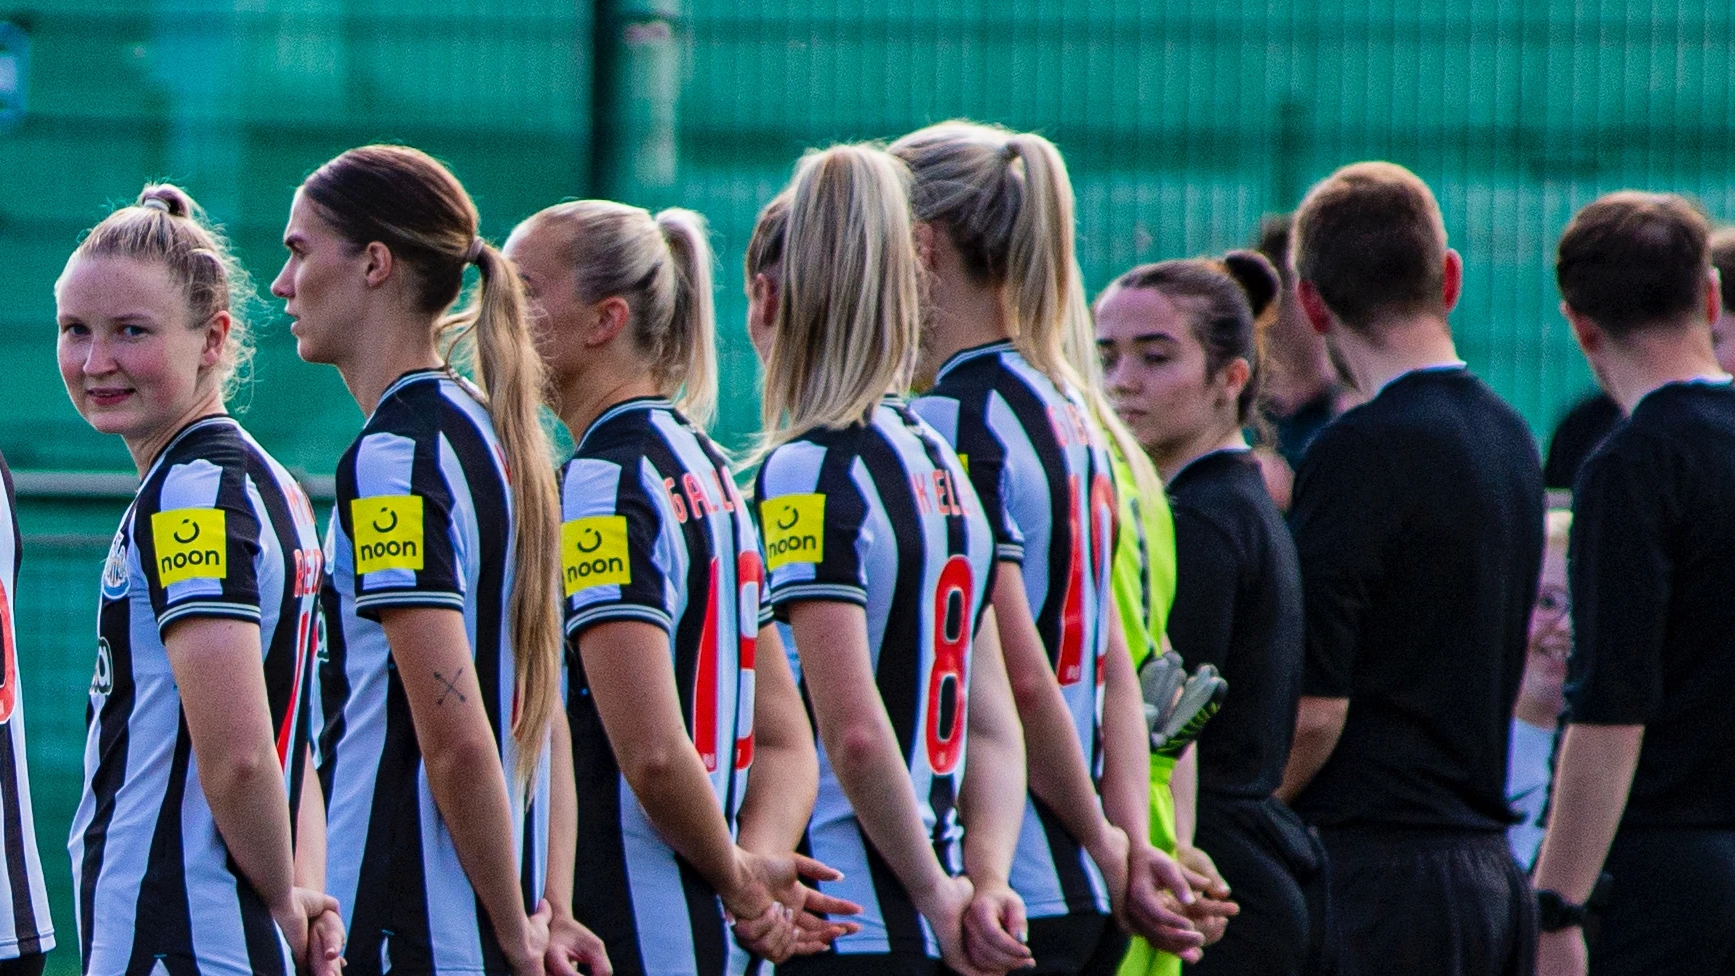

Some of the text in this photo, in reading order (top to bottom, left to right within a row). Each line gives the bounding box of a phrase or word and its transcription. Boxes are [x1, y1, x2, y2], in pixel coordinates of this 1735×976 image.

[361, 537, 418, 561] noon
[768, 531, 818, 557] noon
[160, 548, 220, 572] noon
[568, 552, 624, 581] noon
[925, 554, 973, 776] 8
